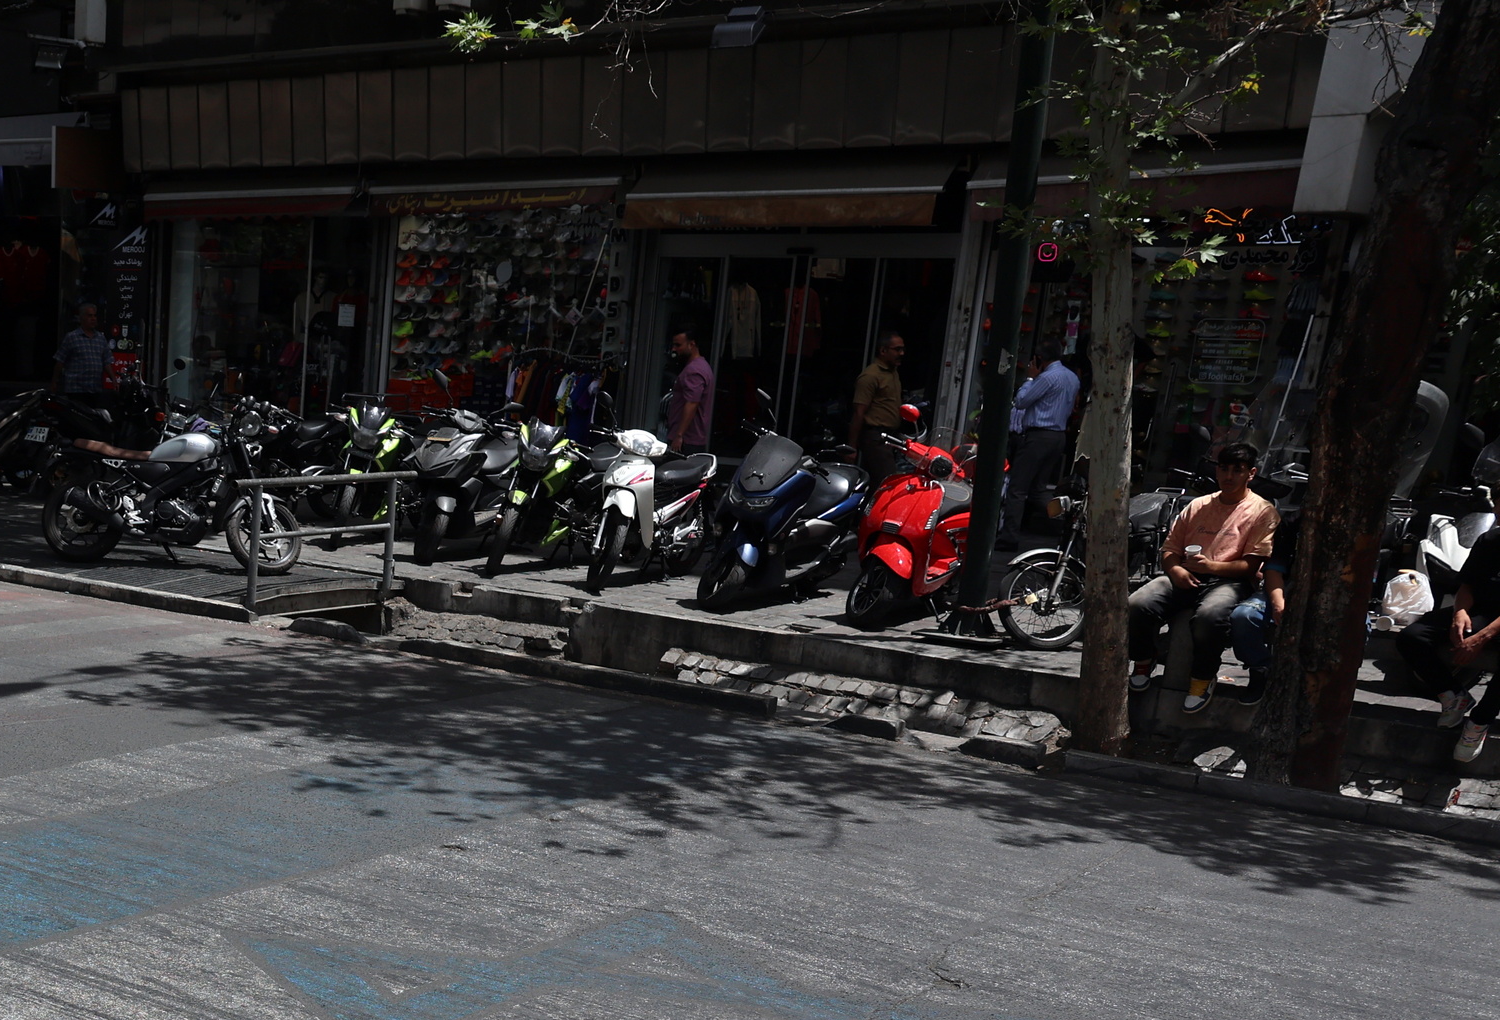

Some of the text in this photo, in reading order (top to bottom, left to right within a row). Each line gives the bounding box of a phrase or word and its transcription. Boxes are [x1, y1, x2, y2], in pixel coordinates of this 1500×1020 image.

[423, 190, 511, 214] اسپرت
[510, 187, 587, 209] امید
[1219, 248, 1289, 271] محمدی
[116, 273, 138, 283] نمایندگی
[118, 310, 133, 319] تهران
